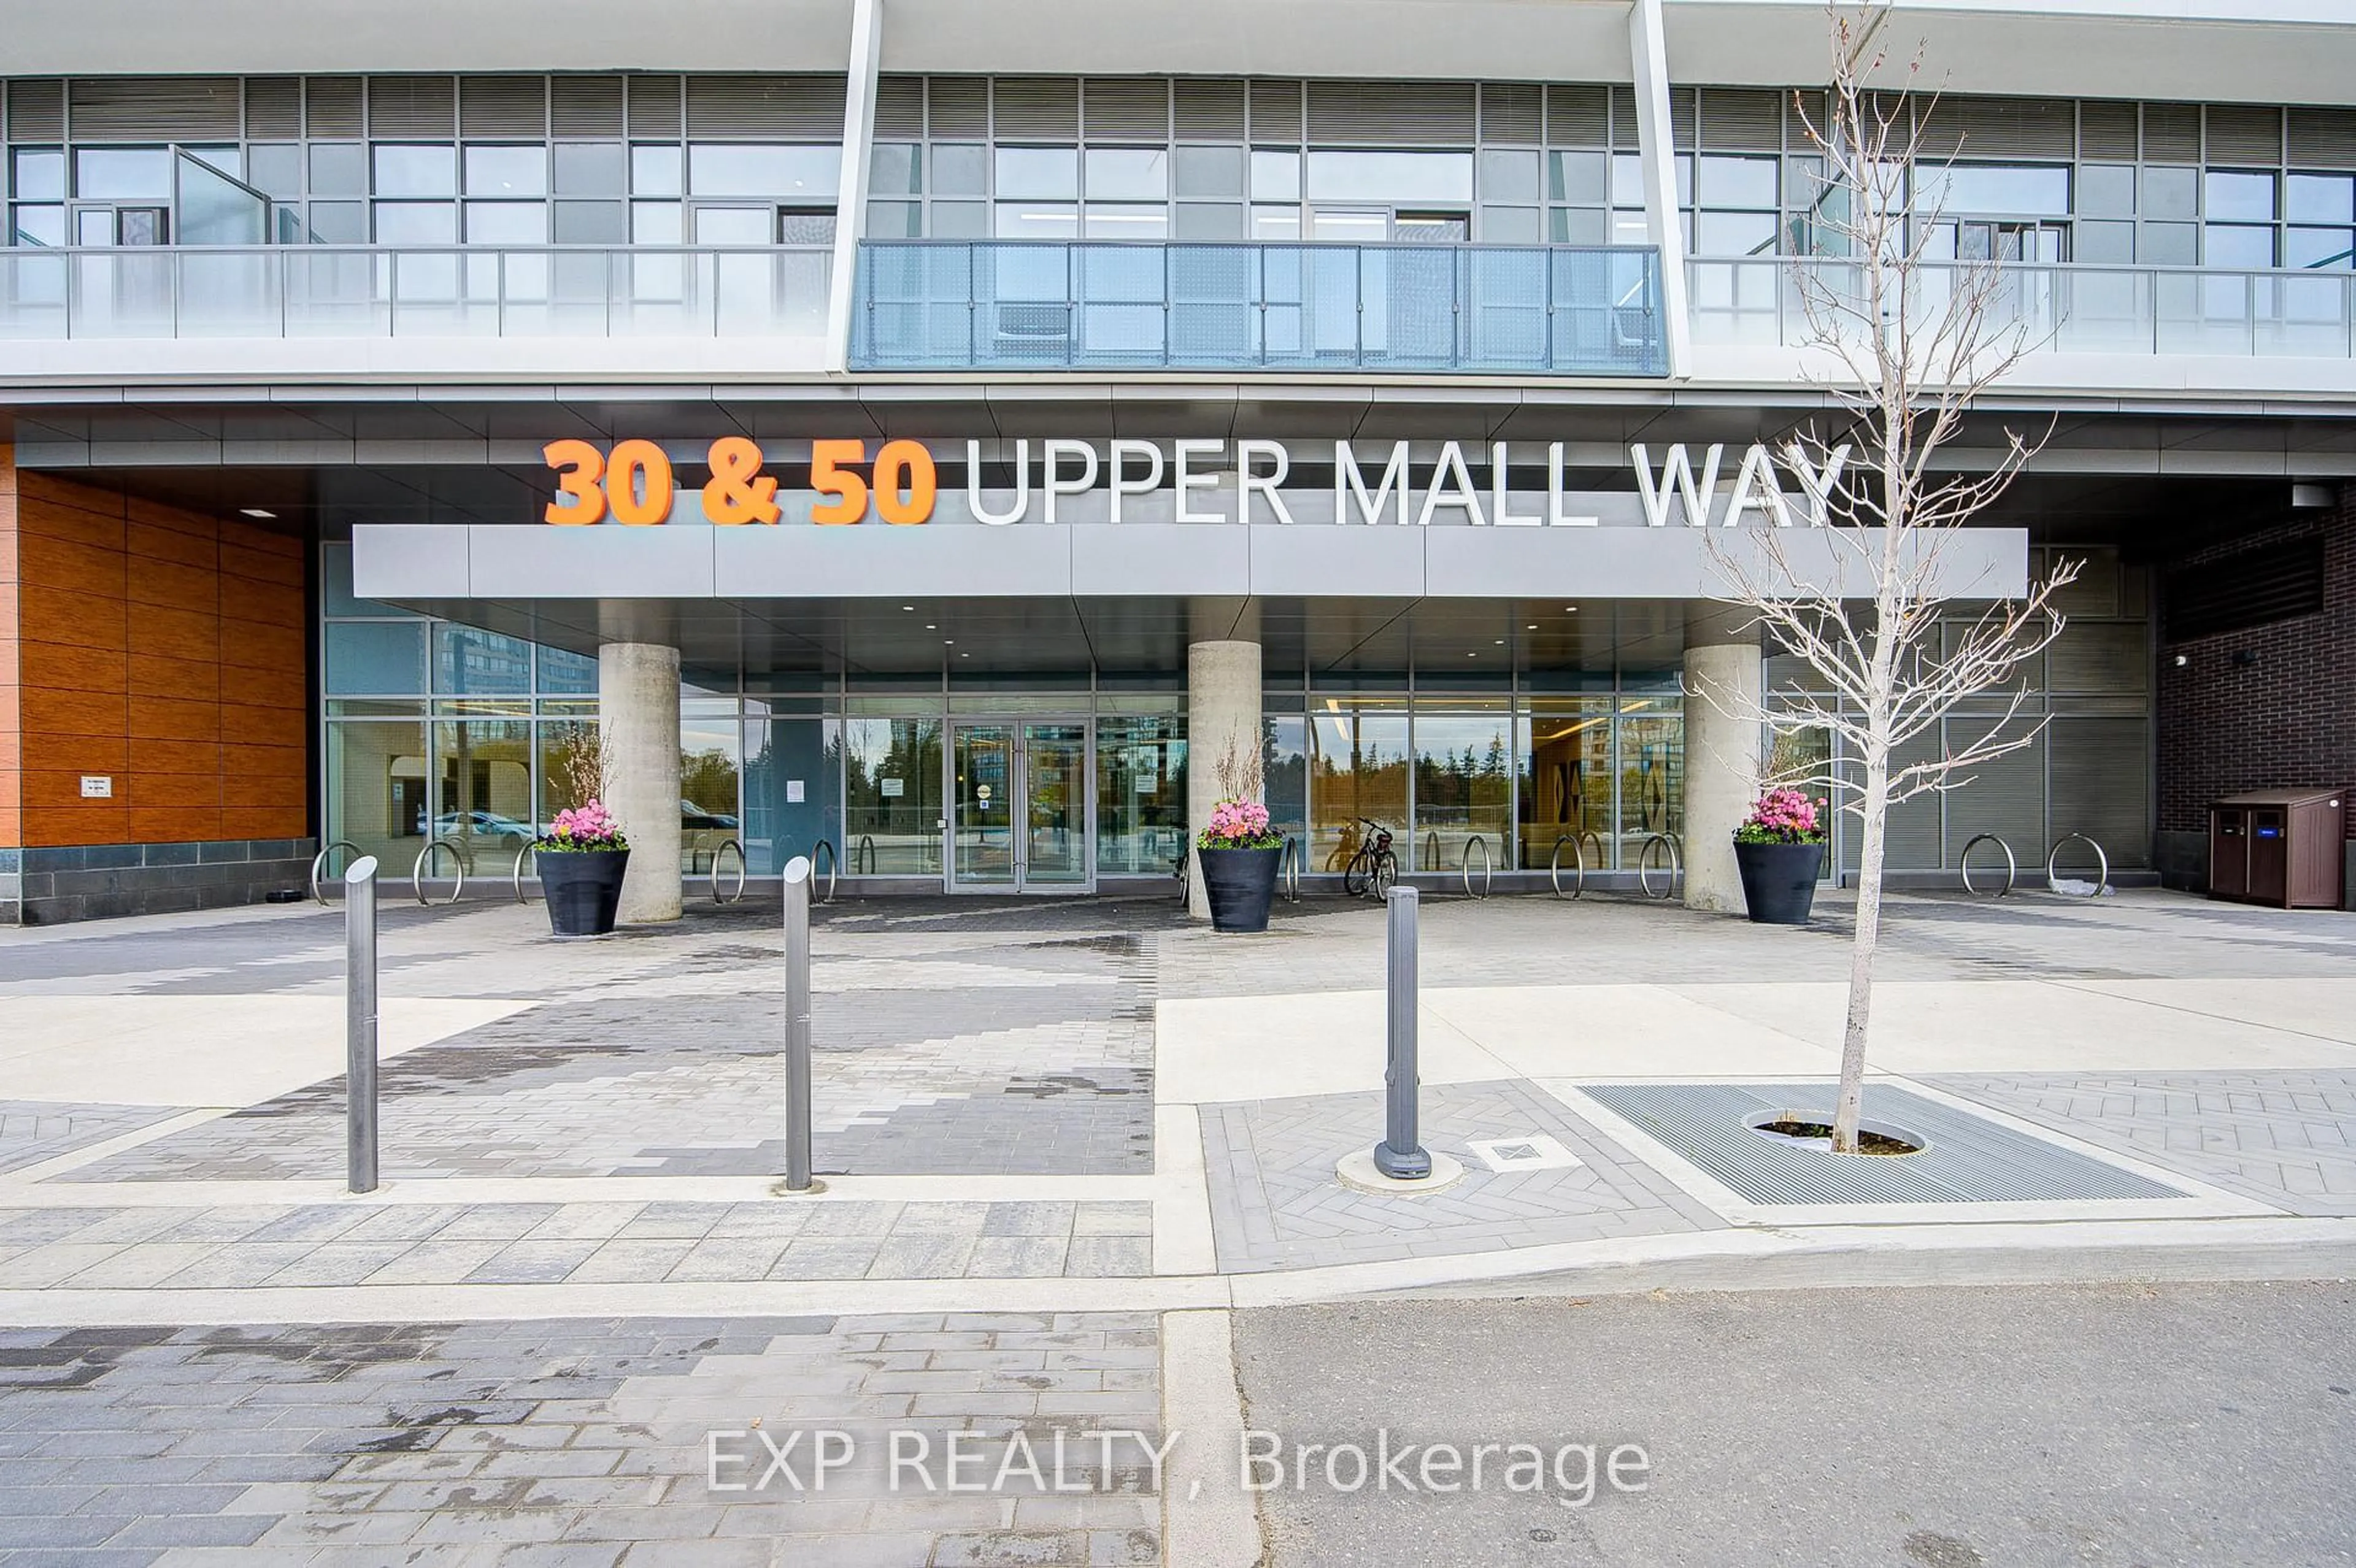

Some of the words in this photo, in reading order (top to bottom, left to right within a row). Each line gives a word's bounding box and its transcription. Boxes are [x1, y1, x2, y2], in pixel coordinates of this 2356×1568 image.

[543, 439, 674, 526] 30
[702, 437, 782, 526] &
[810, 439, 936, 525] 50
[966, 439, 1293, 525] UPPER
[1334, 440, 1599, 527] MALL
[1630, 443, 1852, 528] WAY
